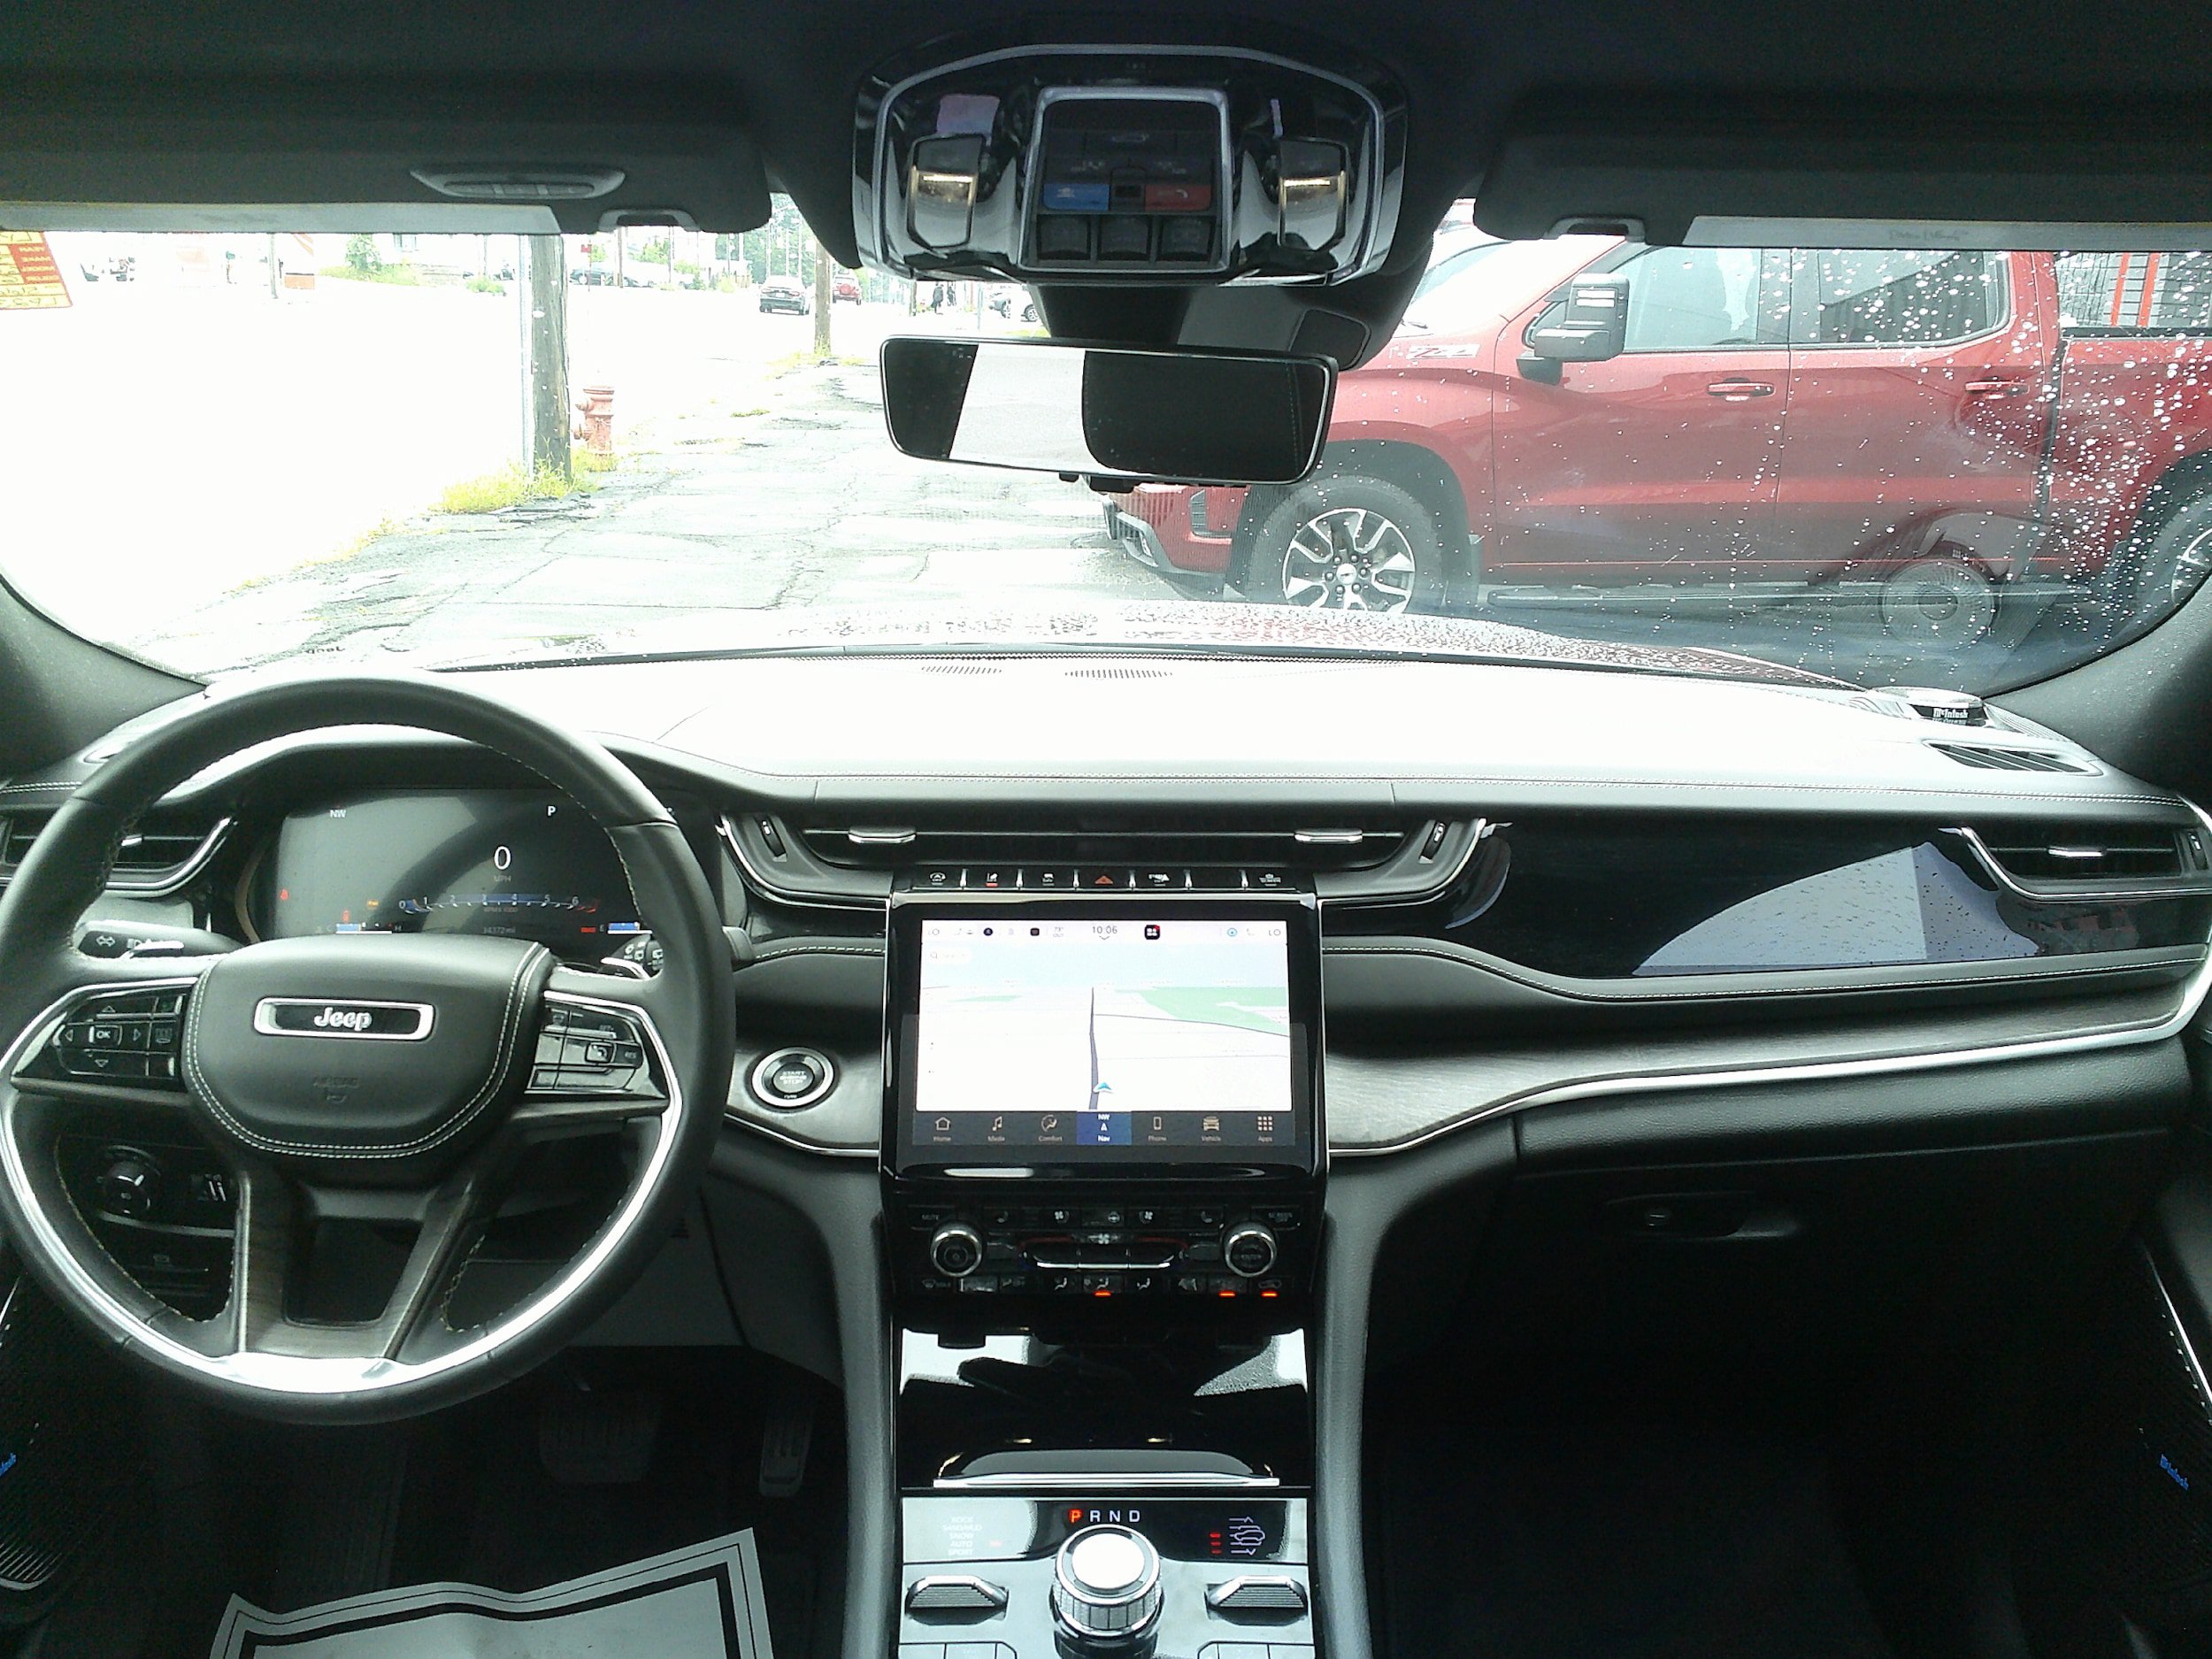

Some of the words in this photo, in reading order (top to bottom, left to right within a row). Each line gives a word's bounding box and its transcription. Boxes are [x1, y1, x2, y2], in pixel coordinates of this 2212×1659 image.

[548, 806, 556, 816] P
[494, 846, 511, 871] 0
[314, 1007, 372, 1031] Jeep
[1071, 1509, 1081, 1522] P
[1090, 1510, 1101, 1522] R
[1110, 1510, 1120, 1522] N
[1129, 1510, 1140, 1522] D
